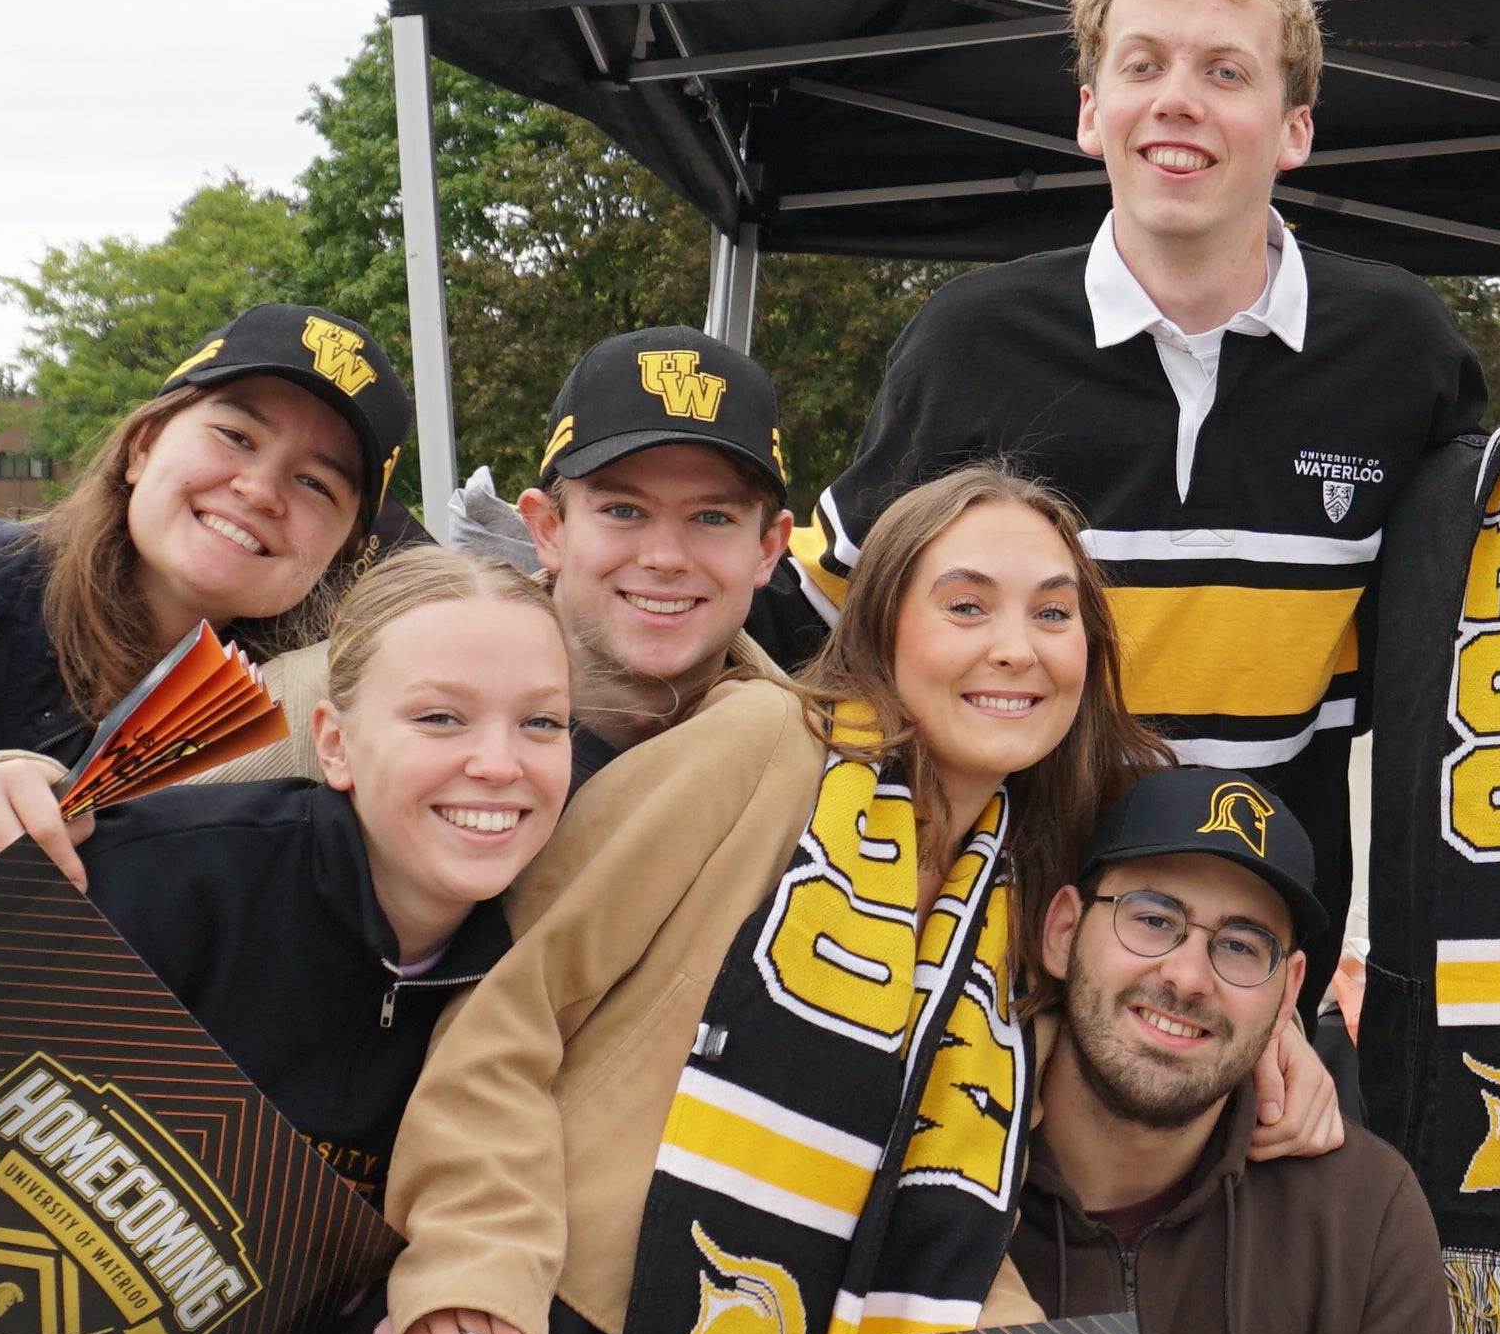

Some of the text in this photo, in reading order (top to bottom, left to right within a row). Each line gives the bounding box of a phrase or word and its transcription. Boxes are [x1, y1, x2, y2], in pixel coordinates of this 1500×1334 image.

[301, 315, 378, 397] UW
[637, 350, 726, 422] UW
[1293, 459, 1384, 483] WATERLOO
[1300, 450, 1380, 467] UNIVERSITY OF
[3, 1161, 150, 1311] UNIVERSITY OF WATERLOO
